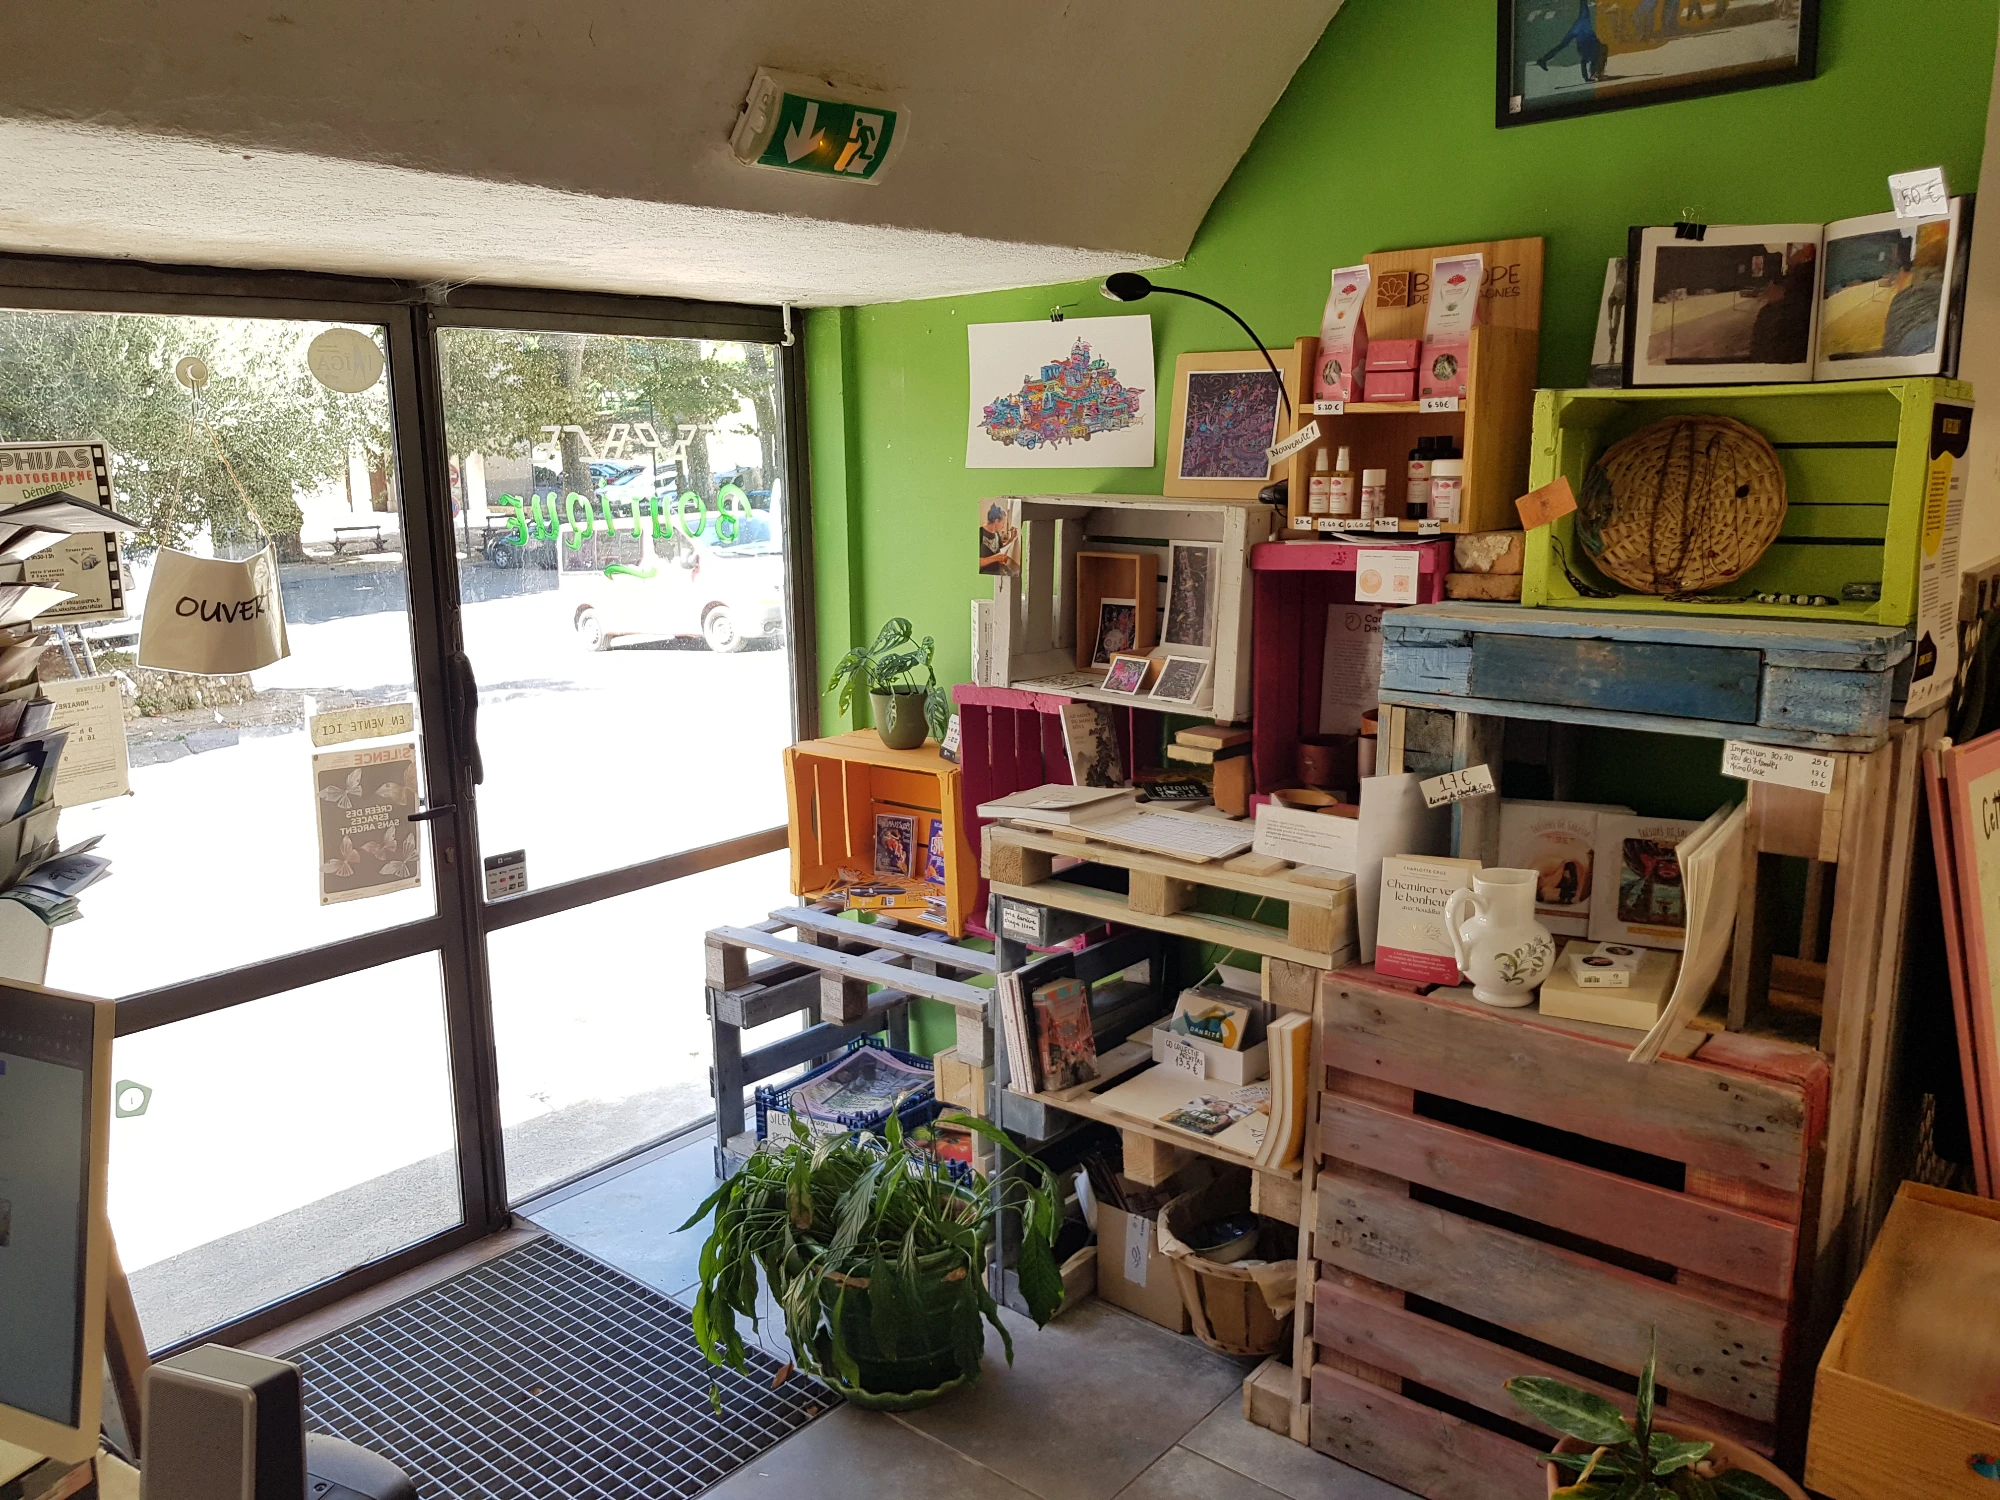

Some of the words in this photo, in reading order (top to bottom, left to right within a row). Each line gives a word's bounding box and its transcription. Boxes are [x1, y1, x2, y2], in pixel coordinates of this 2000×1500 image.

[1901, 188, 1921, 206] 50
[1403, 865, 1432, 874] CHARLOTTE
[1386, 878, 1437, 894] Cheminer
[1439, 886, 1456, 896] ver
[1394, 891, 1404, 901] le
[1405, 892, 1447, 908] bonheu
